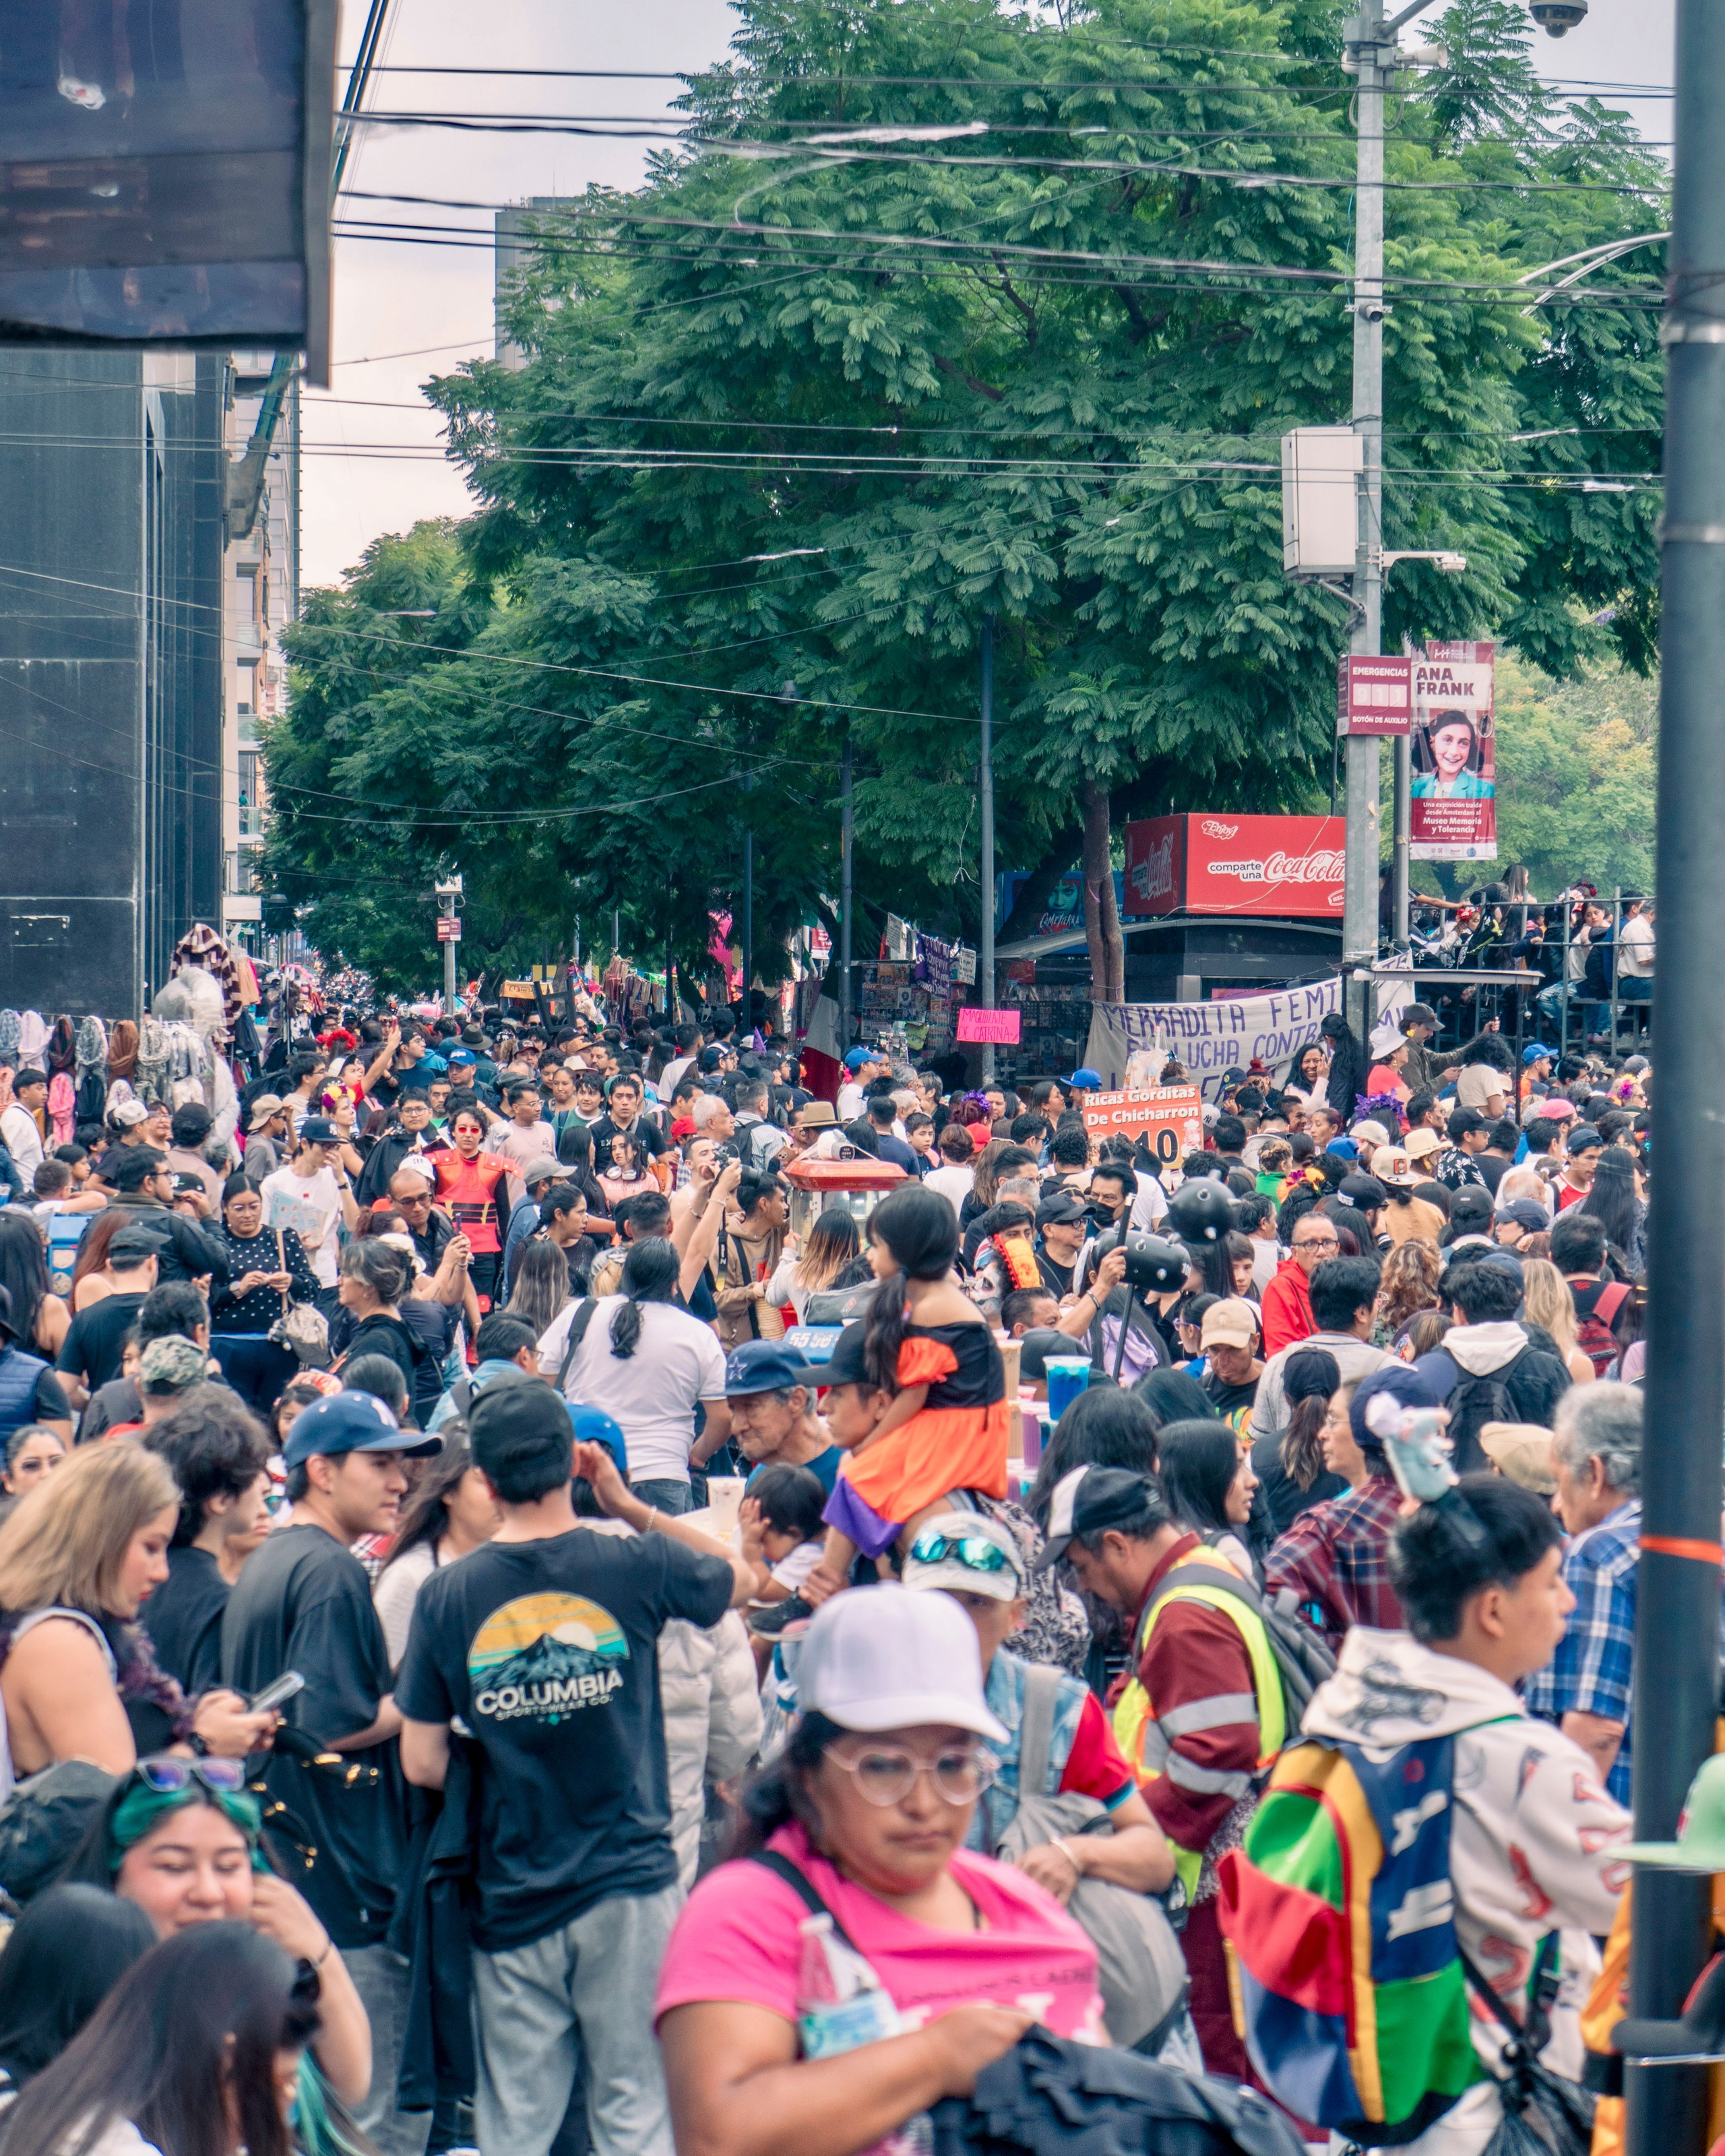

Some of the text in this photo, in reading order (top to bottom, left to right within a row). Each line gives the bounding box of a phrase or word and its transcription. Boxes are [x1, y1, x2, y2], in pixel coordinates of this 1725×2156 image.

[1352, 666, 1408, 677] EMERGENCIAS
[1416, 667, 1453, 680] ANA
[1356, 687, 1403, 704] 911
[1417, 682, 1474, 696] FRANK
[1352, 715, 1375, 723] BOTÓN
[1435, 801, 1464, 809] exposición
[1206, 821, 1238, 836] Enjoy!
[1422, 817, 1448, 825] Museo
[1431, 825, 1475, 835] y Tolerancia
[1210, 862, 1261, 873] comparte
[1103, 1004, 1246, 1038] MERKADITA
[1268, 982, 1338, 1028] FEMI
[958, 1025, 1010, 1042] DE CATRINA
[1253, 1021, 1319, 1060] CONTR
[1085, 1094, 1125, 1108] Ricas
[1128, 1087, 1196, 1104] Gorditas
[1087, 1106, 1199, 1127] De Chicharron
[1119, 1129, 1179, 1164] 10
[788, 1332, 811, 1348] 55
[475, 1668, 624, 1715] COLUMBIA
[495, 1699, 586, 1721] SPORTSWEAR
